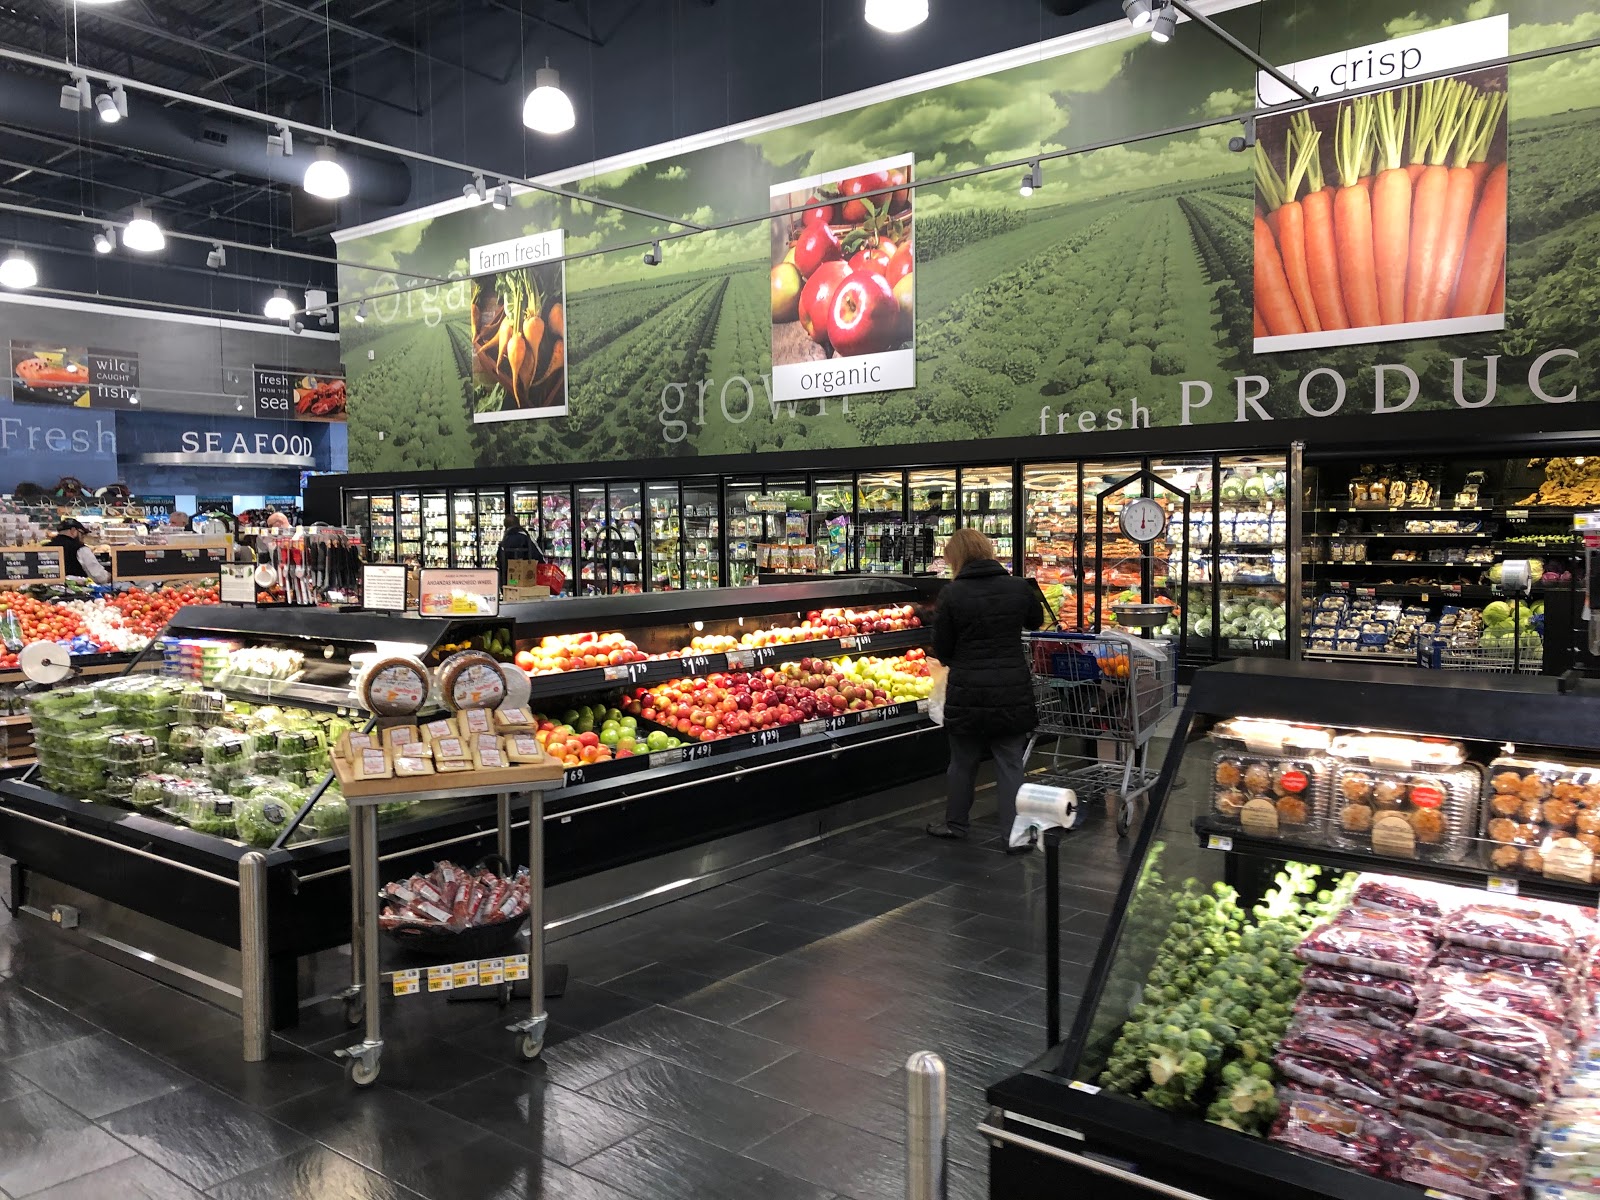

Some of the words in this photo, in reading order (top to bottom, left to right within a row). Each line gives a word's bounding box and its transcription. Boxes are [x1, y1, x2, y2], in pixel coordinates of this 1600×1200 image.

[1330, 47, 1422, 86] crisp
[479, 250, 510, 269] farm
[515, 237, 550, 262] fresh
[96, 372, 130, 381] CAUGHT
[98, 382, 129, 399] fish
[260, 373, 289, 386] fresh
[800, 361, 881, 392] organic
[260, 396, 289, 410] sea
[1039, 396, 1151, 436] fresh
[1178, 348, 1579, 426] PRODUC
[0, 417, 117, 454] Fresh
[181, 431, 313, 457] SEAFOOD
